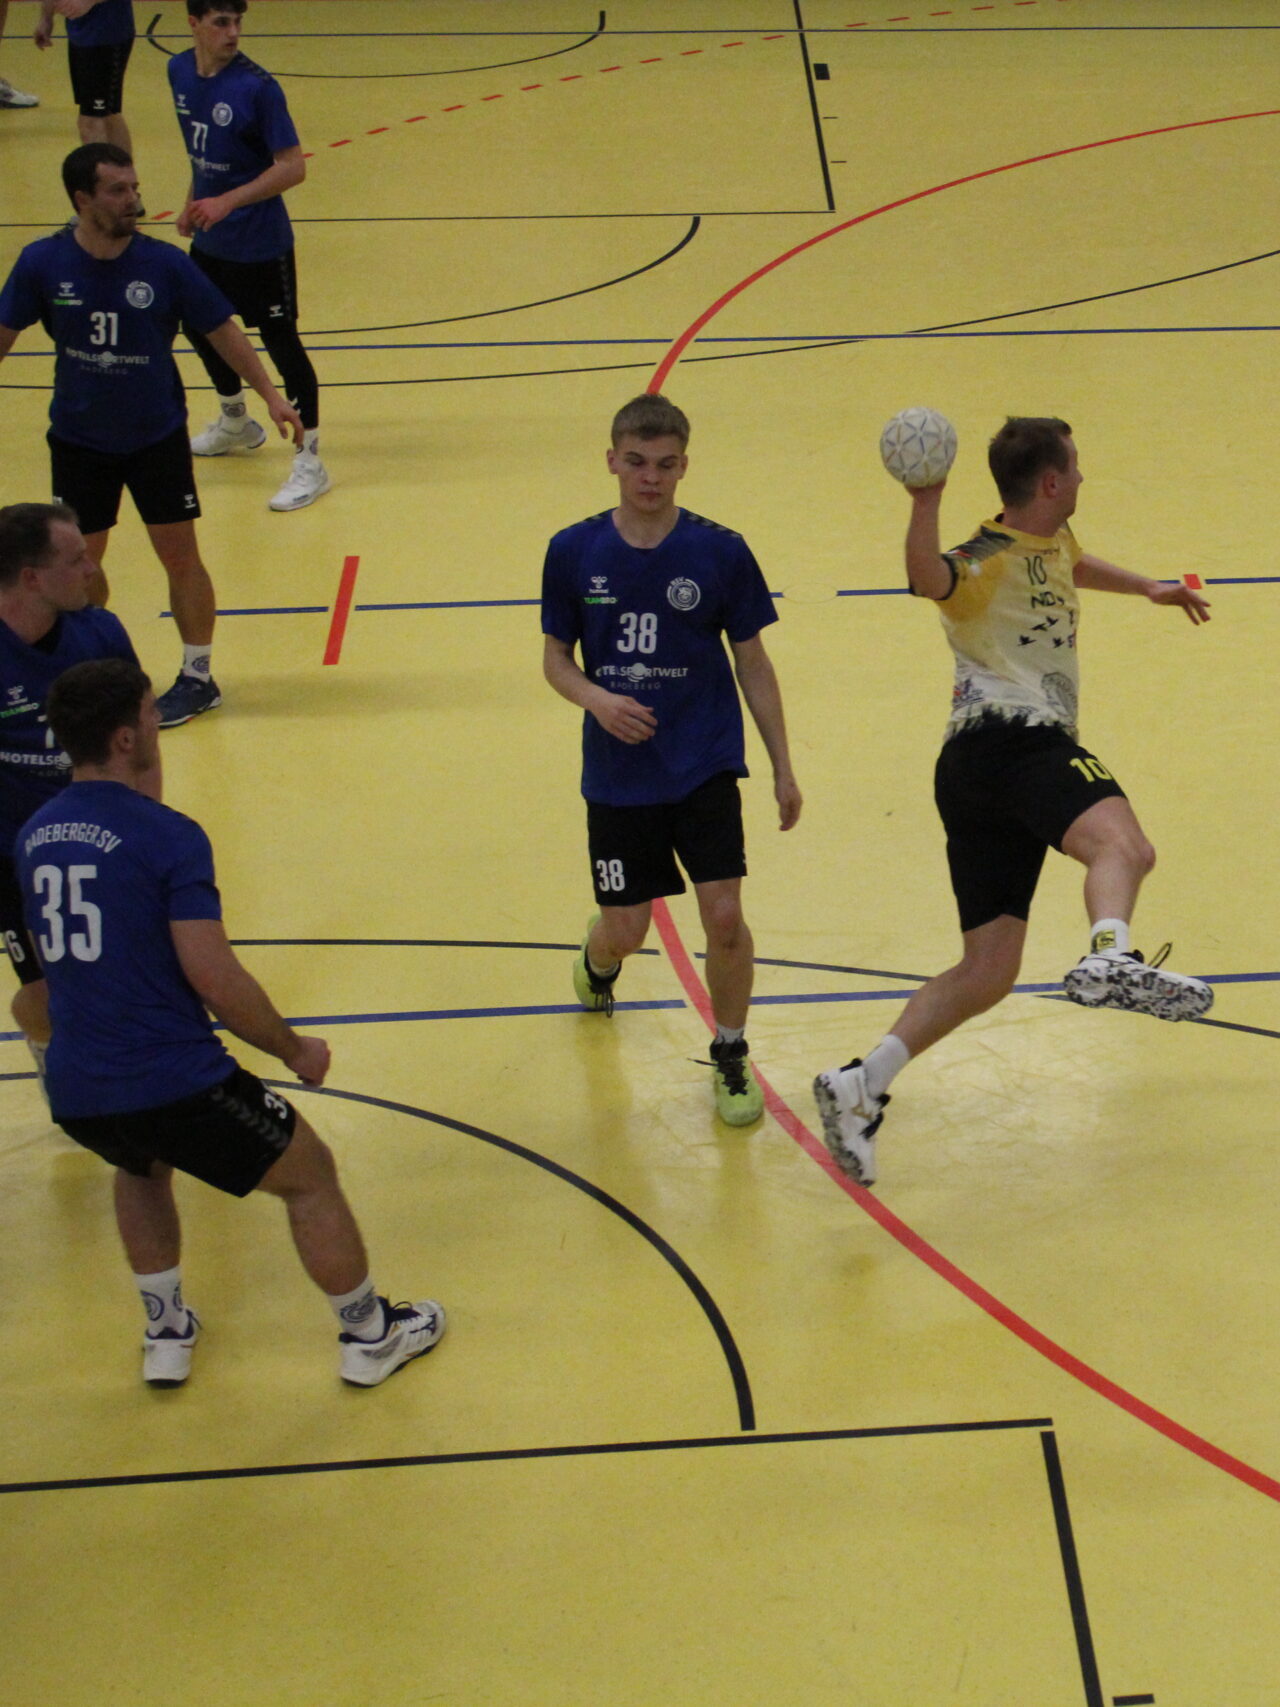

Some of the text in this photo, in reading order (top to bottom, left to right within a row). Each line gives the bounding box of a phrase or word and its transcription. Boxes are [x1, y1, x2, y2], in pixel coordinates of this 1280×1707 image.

[190, 121, 209, 153] 77
[90, 311, 119, 346] 31
[1025, 555, 1047, 586] 10
[616, 612, 658, 655] 38
[1068, 757, 1114, 784] 10
[596, 858, 626, 892] 38
[33, 863, 102, 964] 35
